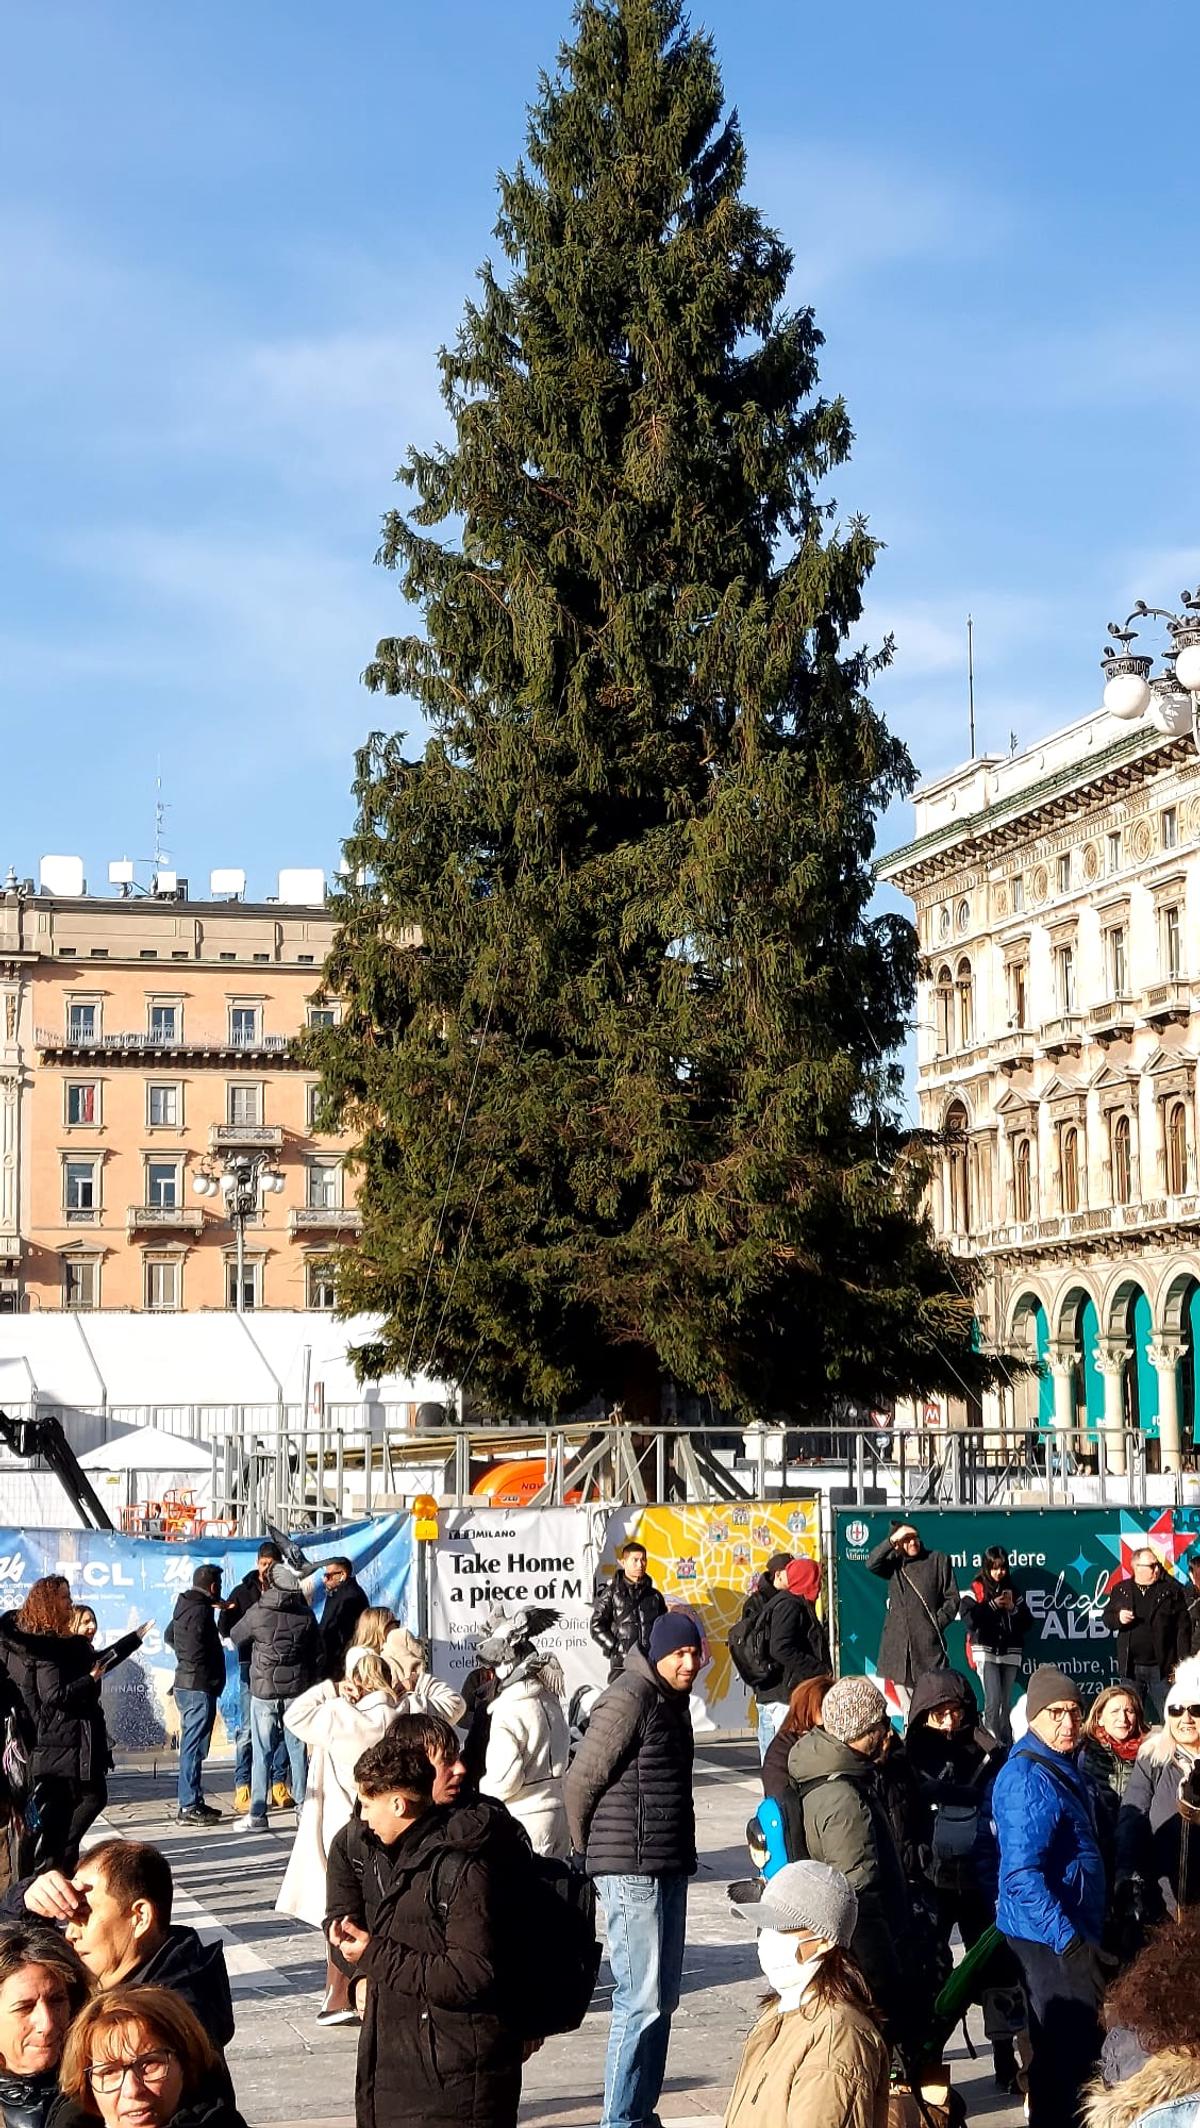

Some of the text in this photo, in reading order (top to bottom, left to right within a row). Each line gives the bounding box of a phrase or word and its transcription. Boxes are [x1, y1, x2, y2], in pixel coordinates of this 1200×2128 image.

[475, 1530, 516, 1538] MILANO
[450, 1553, 575, 1574] Take Home
[972, 1554, 982, 1567] a
[1008, 1550, 1046, 1566] dere
[56, 1561, 134, 1587] TCL
[451, 1587, 463, 1602] a
[470, 1580, 529, 1609] piece
[534, 1578, 557, 1600] of
[558, 1618, 590, 1632] Offici
[1040, 1608, 1119, 1639] ALB
[535, 1637, 562, 1649] 2026
[565, 1636, 588, 1651] pins
[450, 1657, 479, 1669] celeb
[1022, 1655, 1105, 1676] dimbre,
